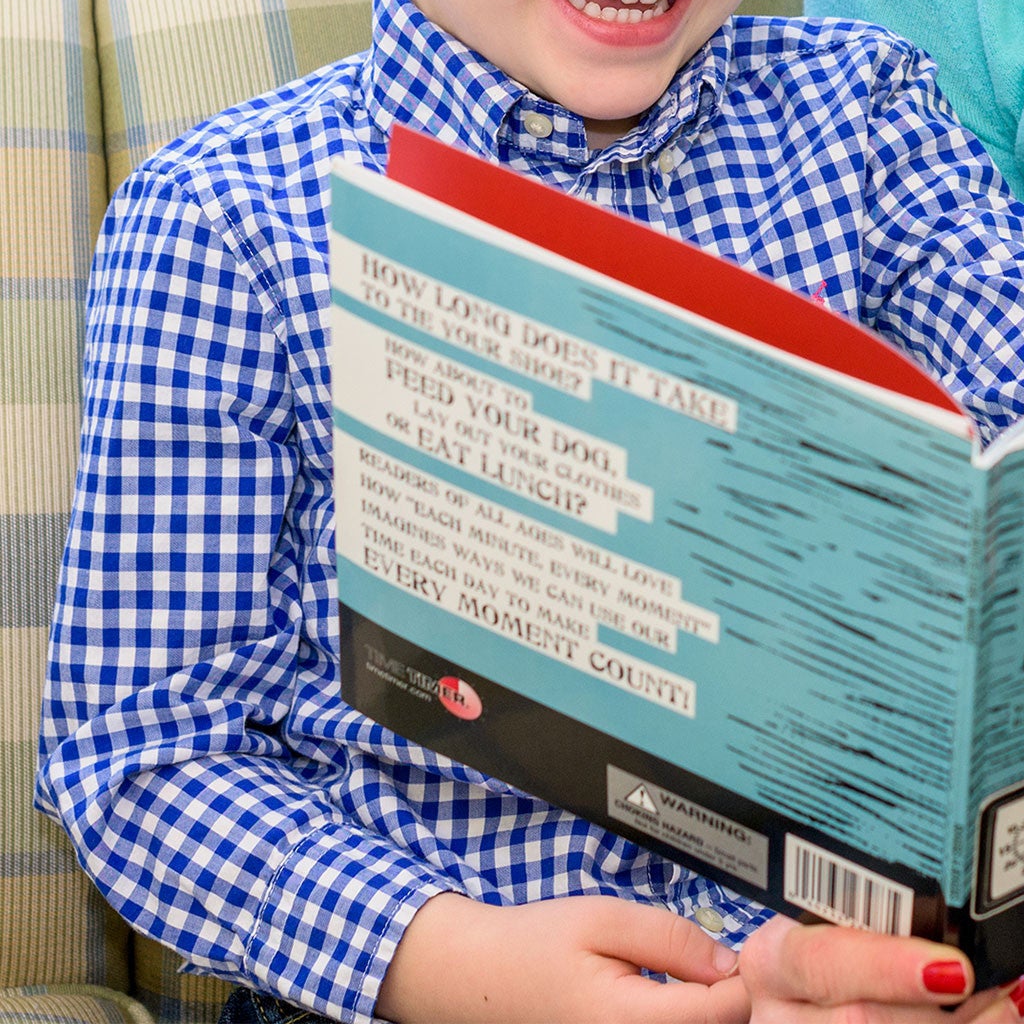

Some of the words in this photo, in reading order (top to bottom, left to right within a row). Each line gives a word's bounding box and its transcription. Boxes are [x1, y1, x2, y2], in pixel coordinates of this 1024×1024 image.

[360, 280, 390, 308] TO
[397, 296, 434, 331] TIE
[442, 317, 502, 360] YOUR
[510, 347, 583, 390] SHOE?
[362, 253, 427, 300] HOW
[435, 285, 511, 338] LONG
[522, 323, 598, 371] DOES
[610, 359, 639, 387] IT
[648, 373, 728, 427] TAKE
[385, 336, 427, 367] HOW
[434, 360, 496, 397] ABOUT
[503, 386, 528, 411] TO
[385, 357, 454, 405] FEED
[466, 394, 541, 445] YOUR
[414, 399, 448, 428] LAY
[455, 420, 491, 446] OUT
[499, 437, 548, 472] YOUR
[555, 463, 641, 511] CLOTHES
[359, 447, 439, 497] READERS
[445, 489, 469, 509] OF
[475, 503, 511, 528] ALL
[516, 520, 565, 551] AGES
[571, 541, 618, 574] WILL
[623, 564, 674, 597] LOVE
[385, 412, 411, 436] OR
[418, 426, 472, 465] EAT
[482, 452, 588, 516] LUNCH?
[360, 473, 401, 503] HOW
[550, 559, 611, 596] EVERY
[360, 522, 404, 558] TIME
[410, 548, 456, 581] EACH
[463, 572, 499, 599] DAY
[506, 590, 531, 613] TO
[537, 604, 590, 641] MAKE
[361, 499, 446, 550] IMAGINES
[452, 542, 506, 576] WAYS
[511, 567, 541, 593] WE
[545, 583, 583, 611] CAN
[589, 602, 625, 631] USE
[631, 621, 670, 648] OUR
[364, 546, 446, 602] EVERY
[457, 592, 579, 659] MOMENT
[589, 650, 690, 710] COUNT!
